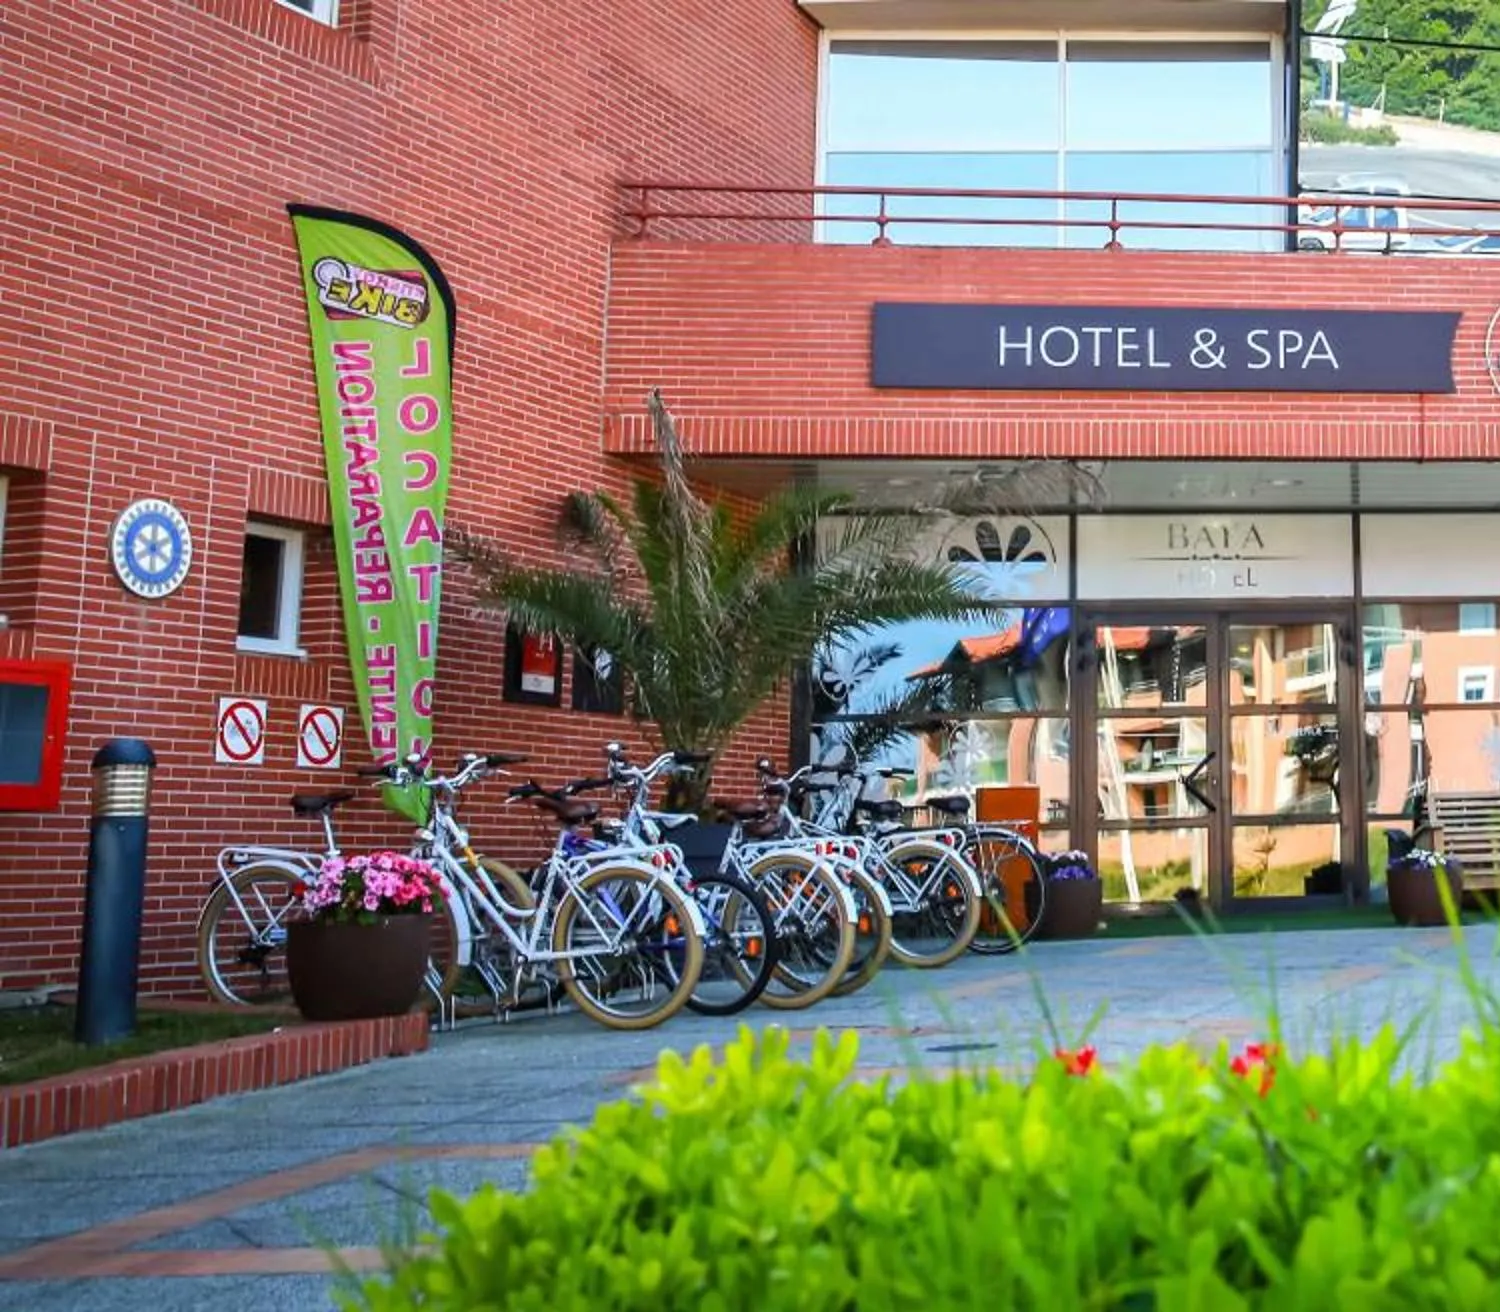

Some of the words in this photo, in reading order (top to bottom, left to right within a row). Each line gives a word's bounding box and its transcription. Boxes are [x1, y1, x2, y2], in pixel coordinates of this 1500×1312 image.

[999, 326, 1171, 368] HOTEL
[1190, 328, 1227, 368] &
[1248, 329, 1339, 369] SPA
[1168, 523, 1265, 549] BAYA
